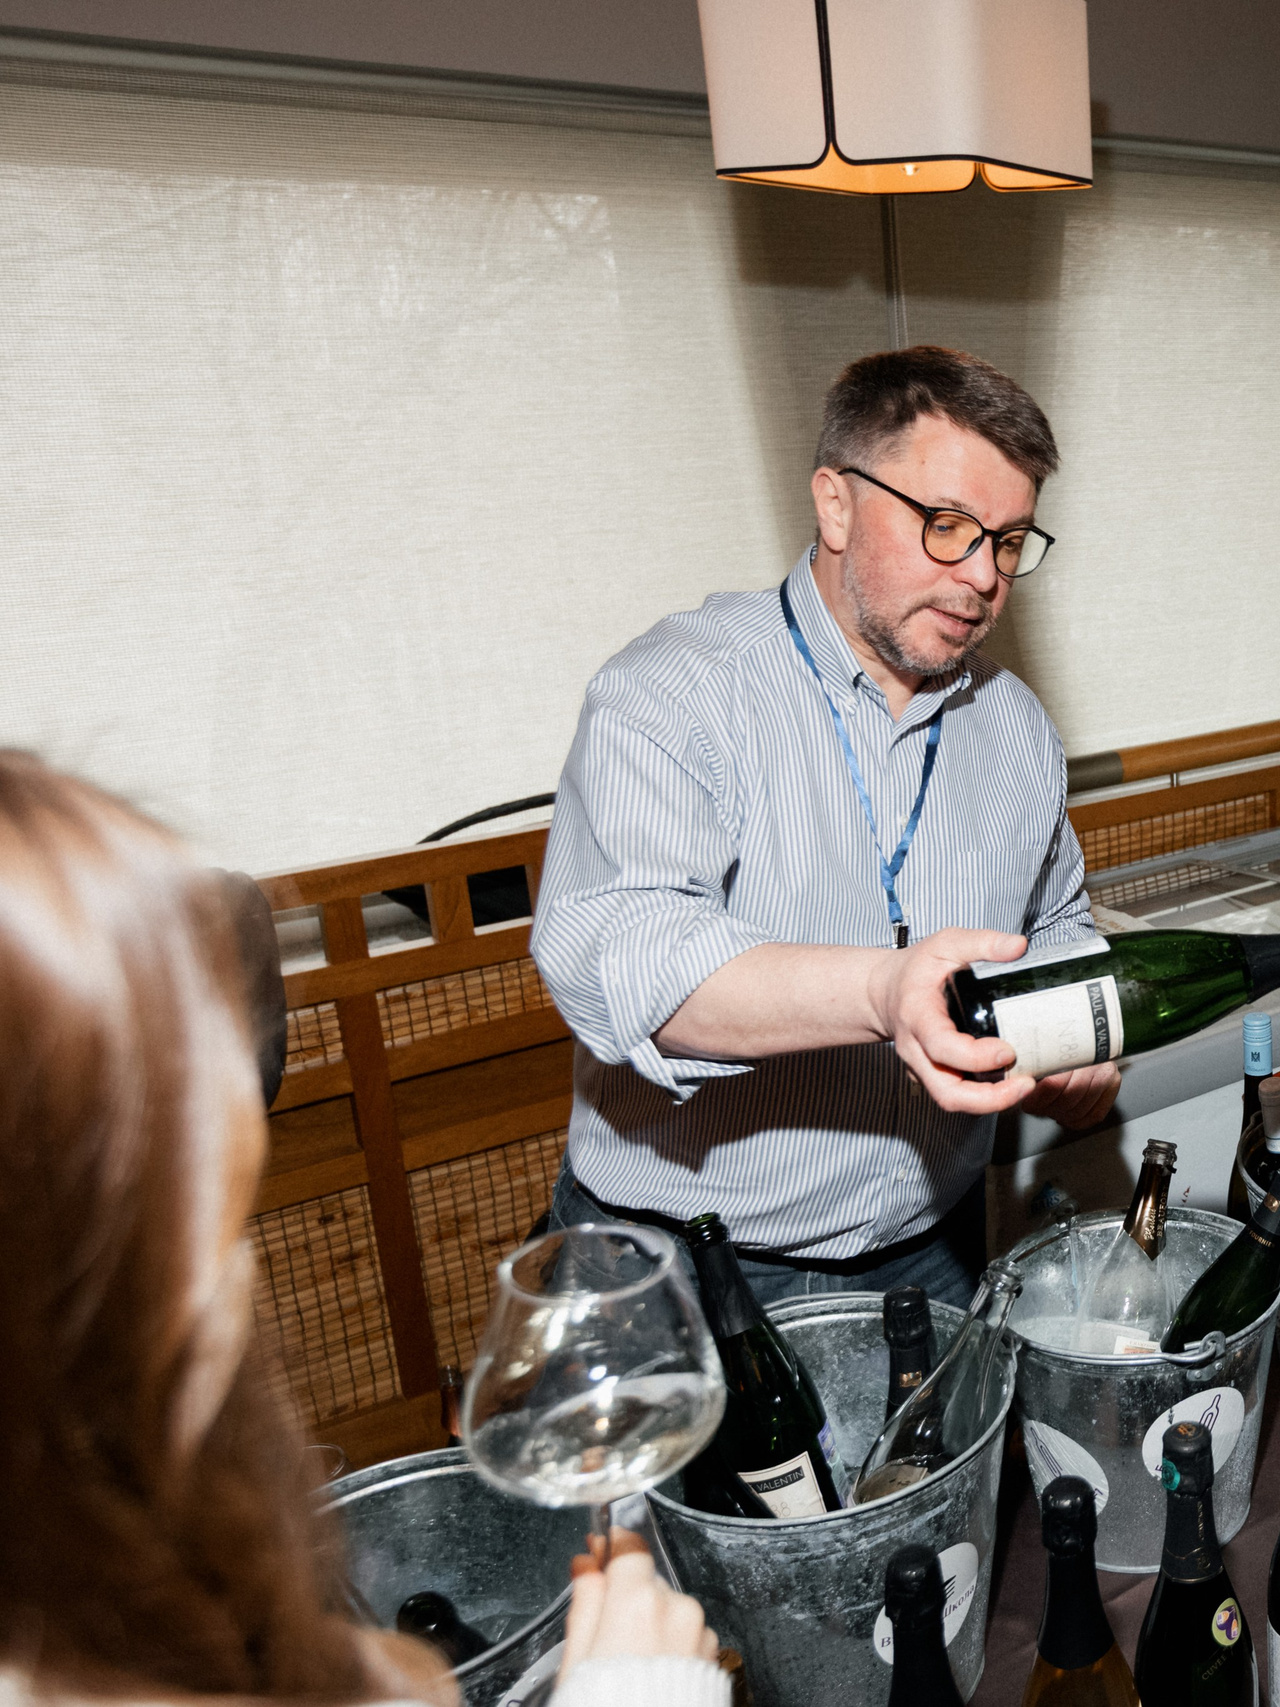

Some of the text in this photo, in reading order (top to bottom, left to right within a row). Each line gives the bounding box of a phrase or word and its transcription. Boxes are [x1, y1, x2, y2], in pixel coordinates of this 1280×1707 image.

[1089, 986, 1103, 1016] PAUL
[1095, 1016, 1106, 1026] G
[756, 1468, 804, 1491] VALENTIN
